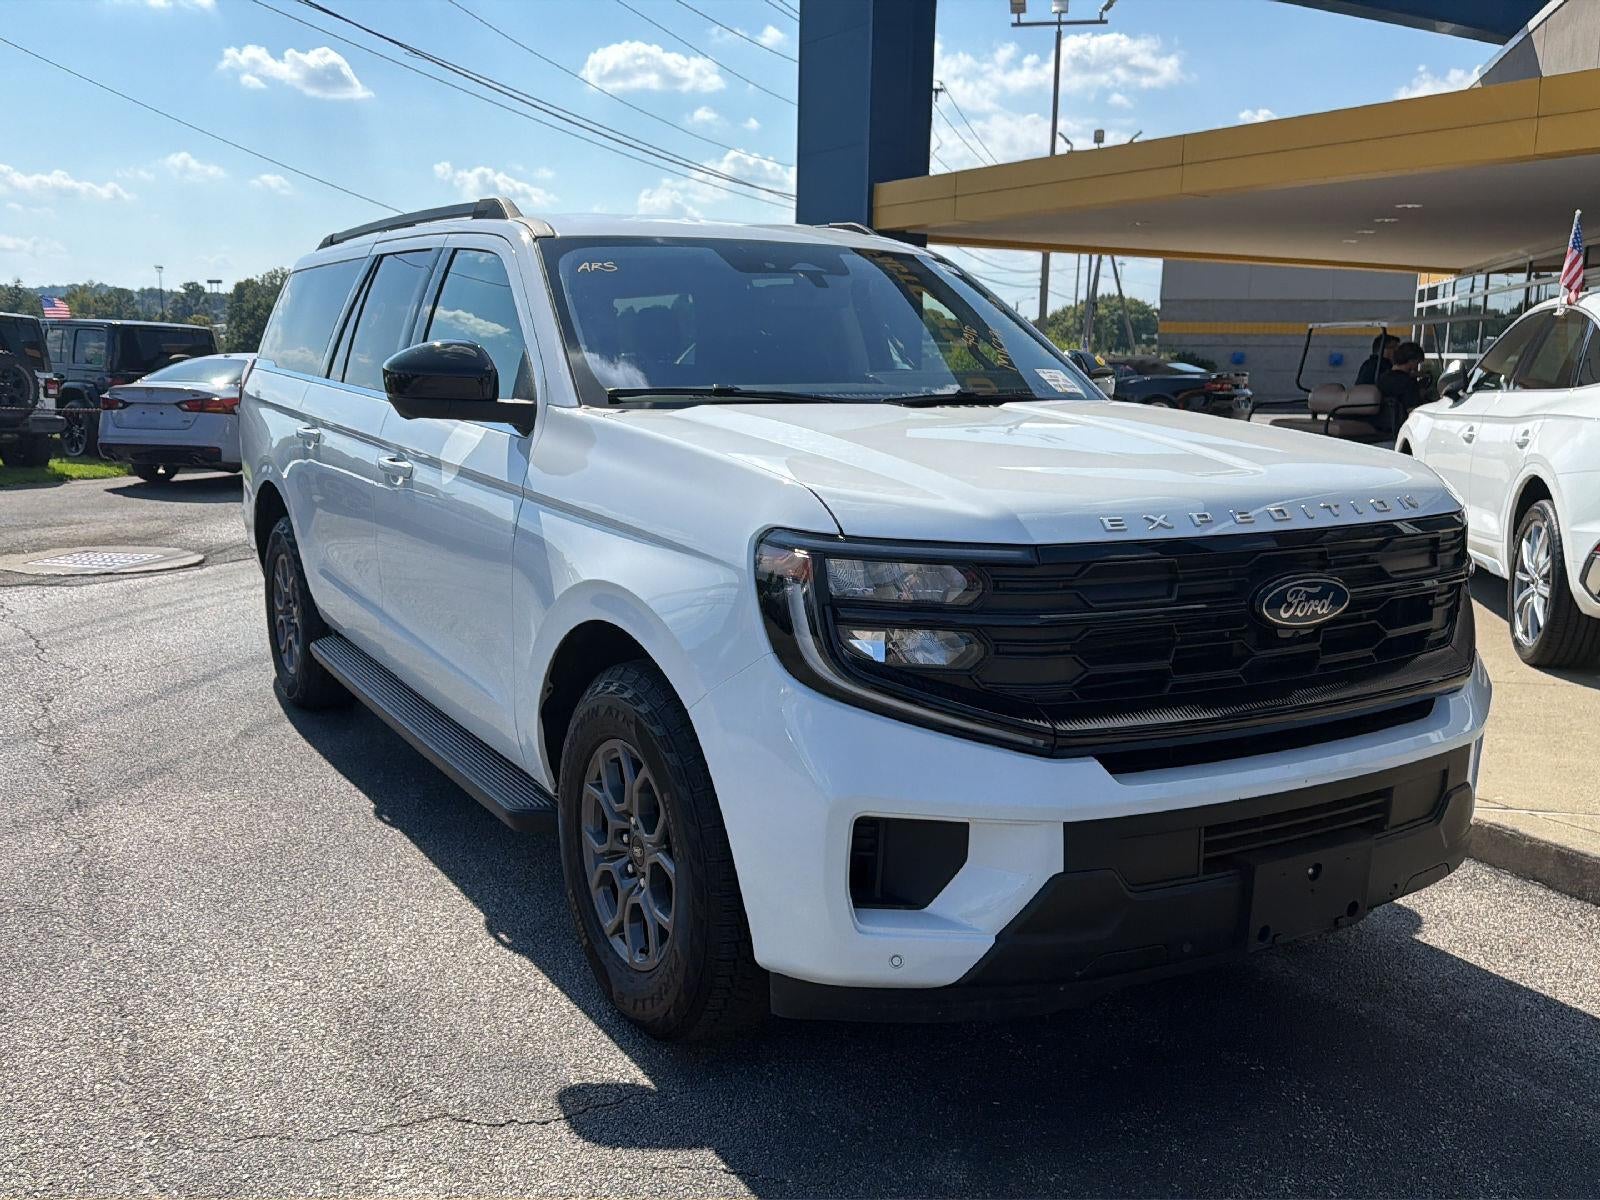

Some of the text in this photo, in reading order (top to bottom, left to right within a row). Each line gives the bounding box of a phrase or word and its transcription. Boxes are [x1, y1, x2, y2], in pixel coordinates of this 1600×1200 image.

[577, 261, 618, 273] ARS
[1099, 494, 1419, 533] EXPEDITION
[1279, 585, 1335, 619] Ford
